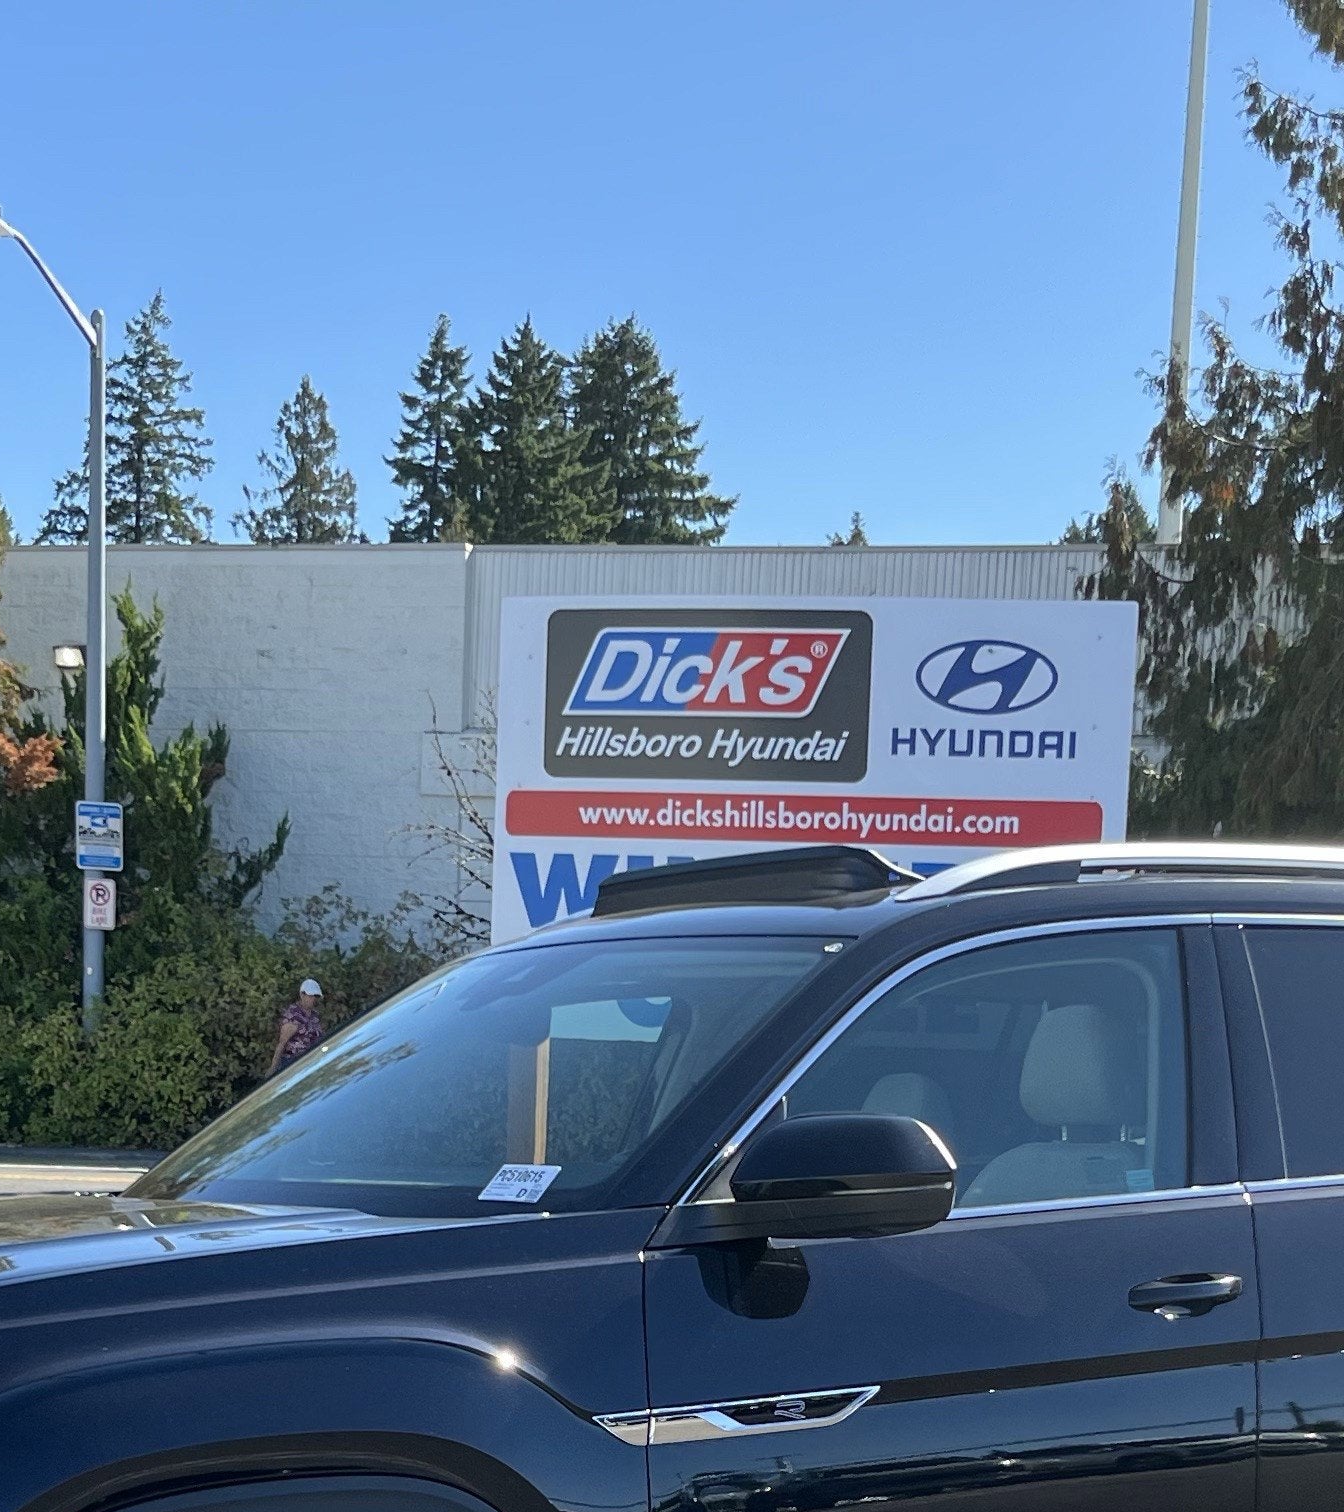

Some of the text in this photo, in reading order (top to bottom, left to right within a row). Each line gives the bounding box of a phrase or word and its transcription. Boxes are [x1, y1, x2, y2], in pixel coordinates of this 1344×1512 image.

[584, 638, 814, 705] Dick's
[555, 726, 850, 767] Hillsboro Hyundai
[891, 727, 1077, 760] HYUNDAI
[578, 798, 1020, 836] www.dickshillsborohyundai.com
